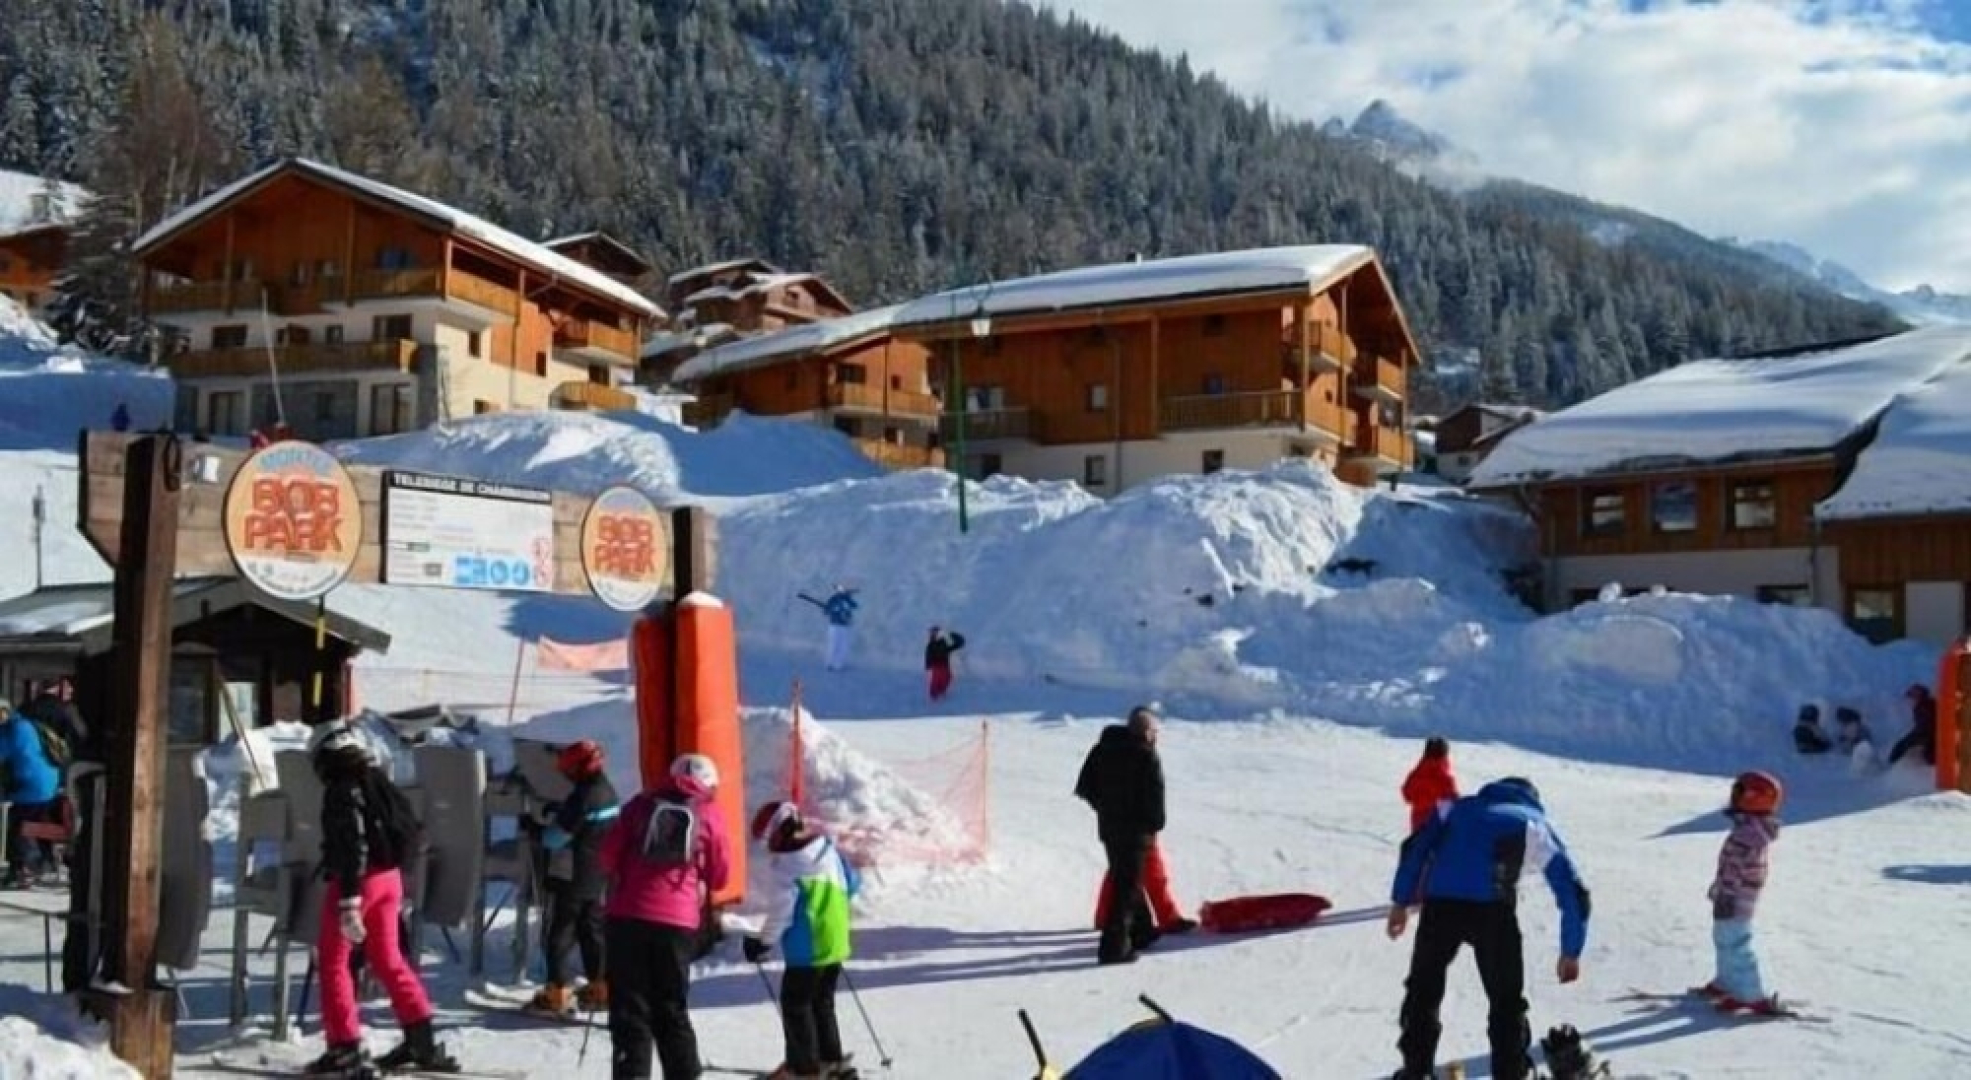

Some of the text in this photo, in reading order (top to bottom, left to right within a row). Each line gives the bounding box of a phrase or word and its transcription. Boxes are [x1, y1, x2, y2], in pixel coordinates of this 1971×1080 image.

[252, 478, 340, 515] BOB
[460, 481, 474, 493] DE
[244, 510, 343, 552] PARK
[596, 512, 655, 546] BOB
[591, 537, 657, 575] PARK
